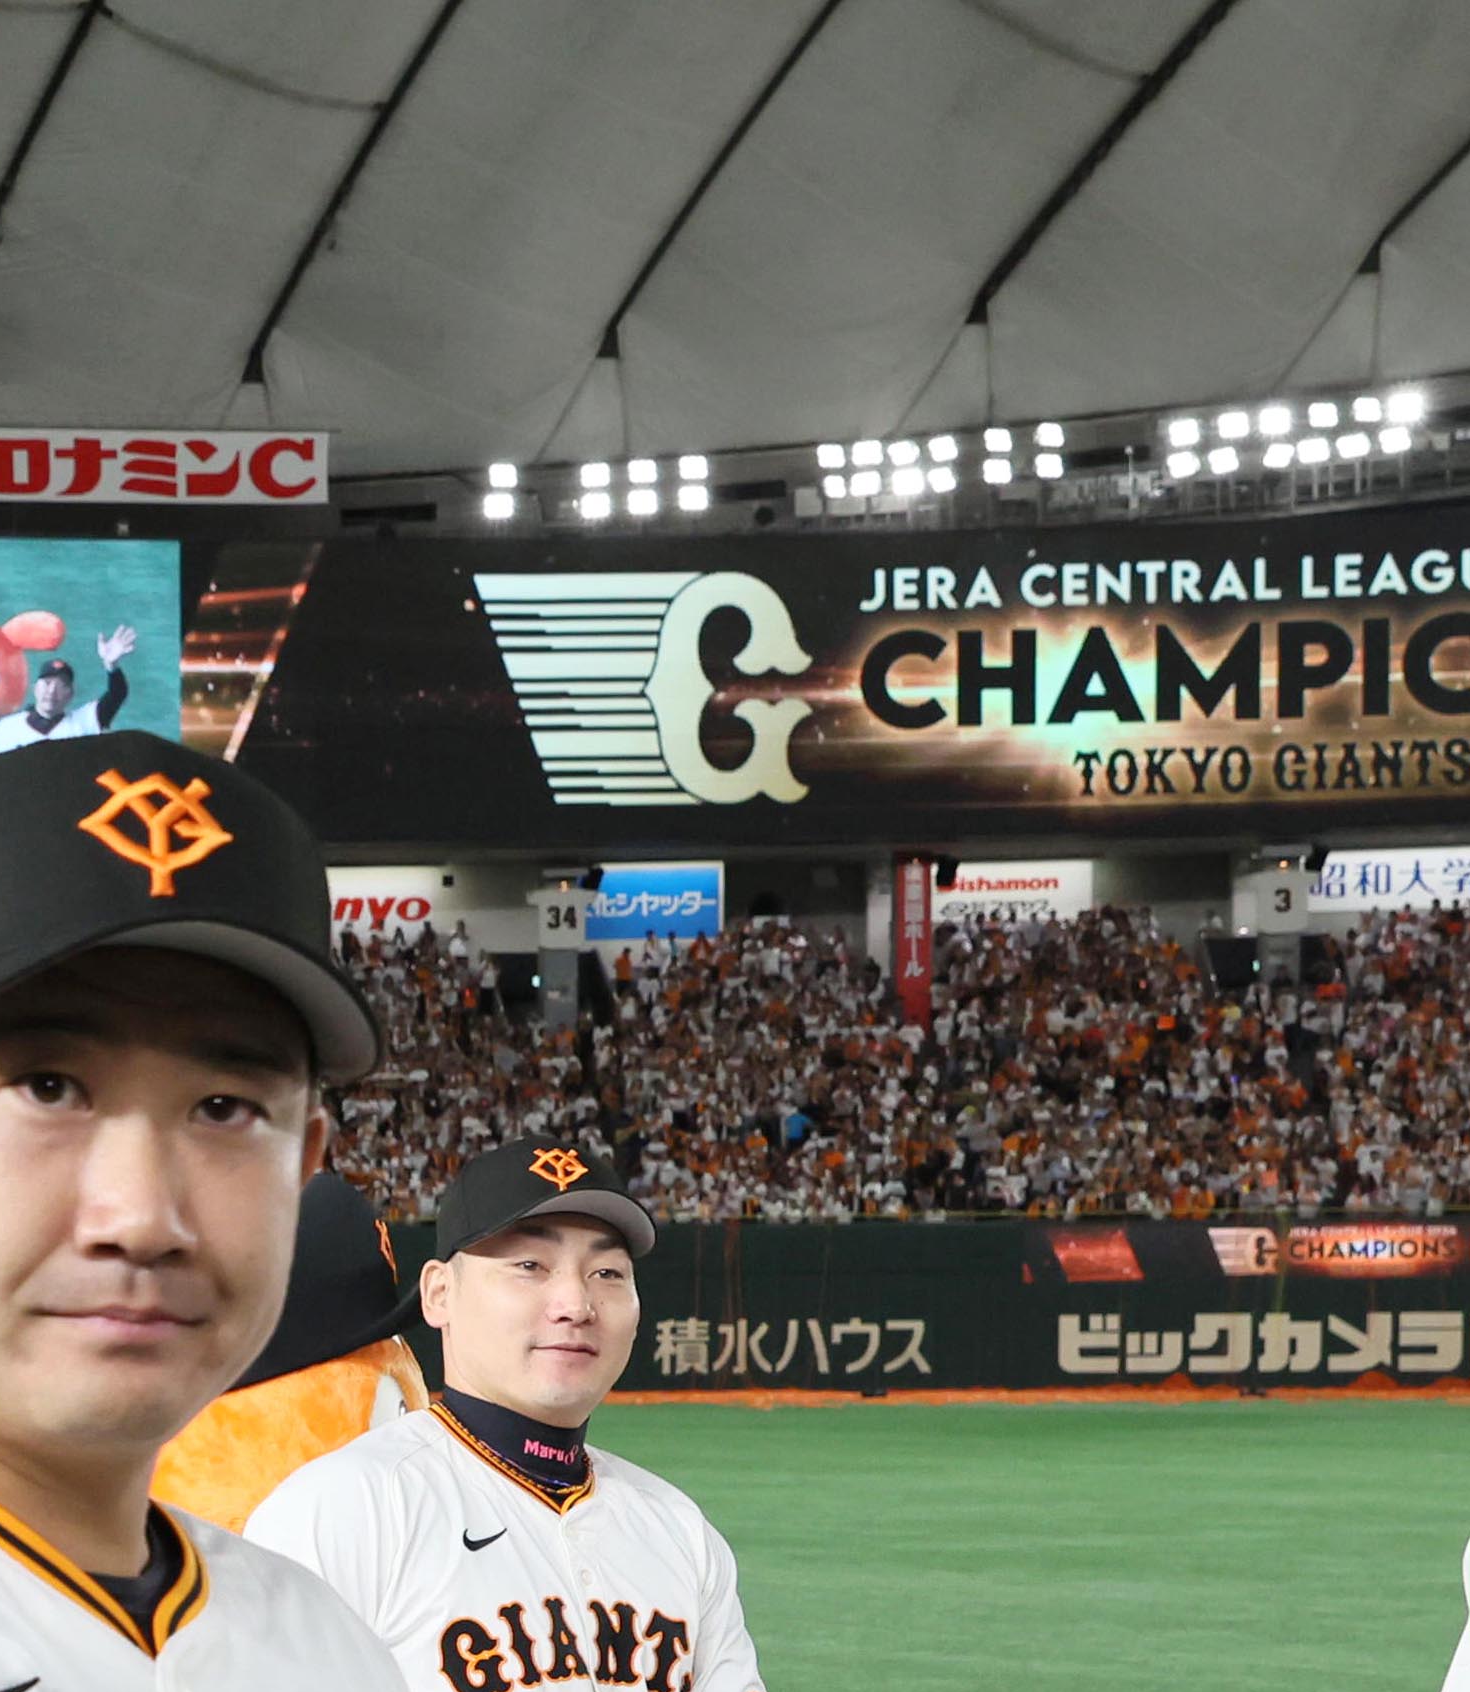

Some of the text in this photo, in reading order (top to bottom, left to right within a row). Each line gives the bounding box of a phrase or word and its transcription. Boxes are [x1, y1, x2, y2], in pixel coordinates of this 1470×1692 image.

[859, 548, 1470, 613] JERA CENTRAL LEAG
[1074, 738, 1470, 797] TOKYO GIANTS
[936, 875, 1060, 893] ishamon
[1274, 888, 1292, 913] 3
[546, 905, 577, 930] 34
[1289, 1238, 1456, 1259] CHAMPIONS
[653, 1316, 932, 1376] 積水ハウス
[1057, 1310, 1464, 1375] ビックカメラ
